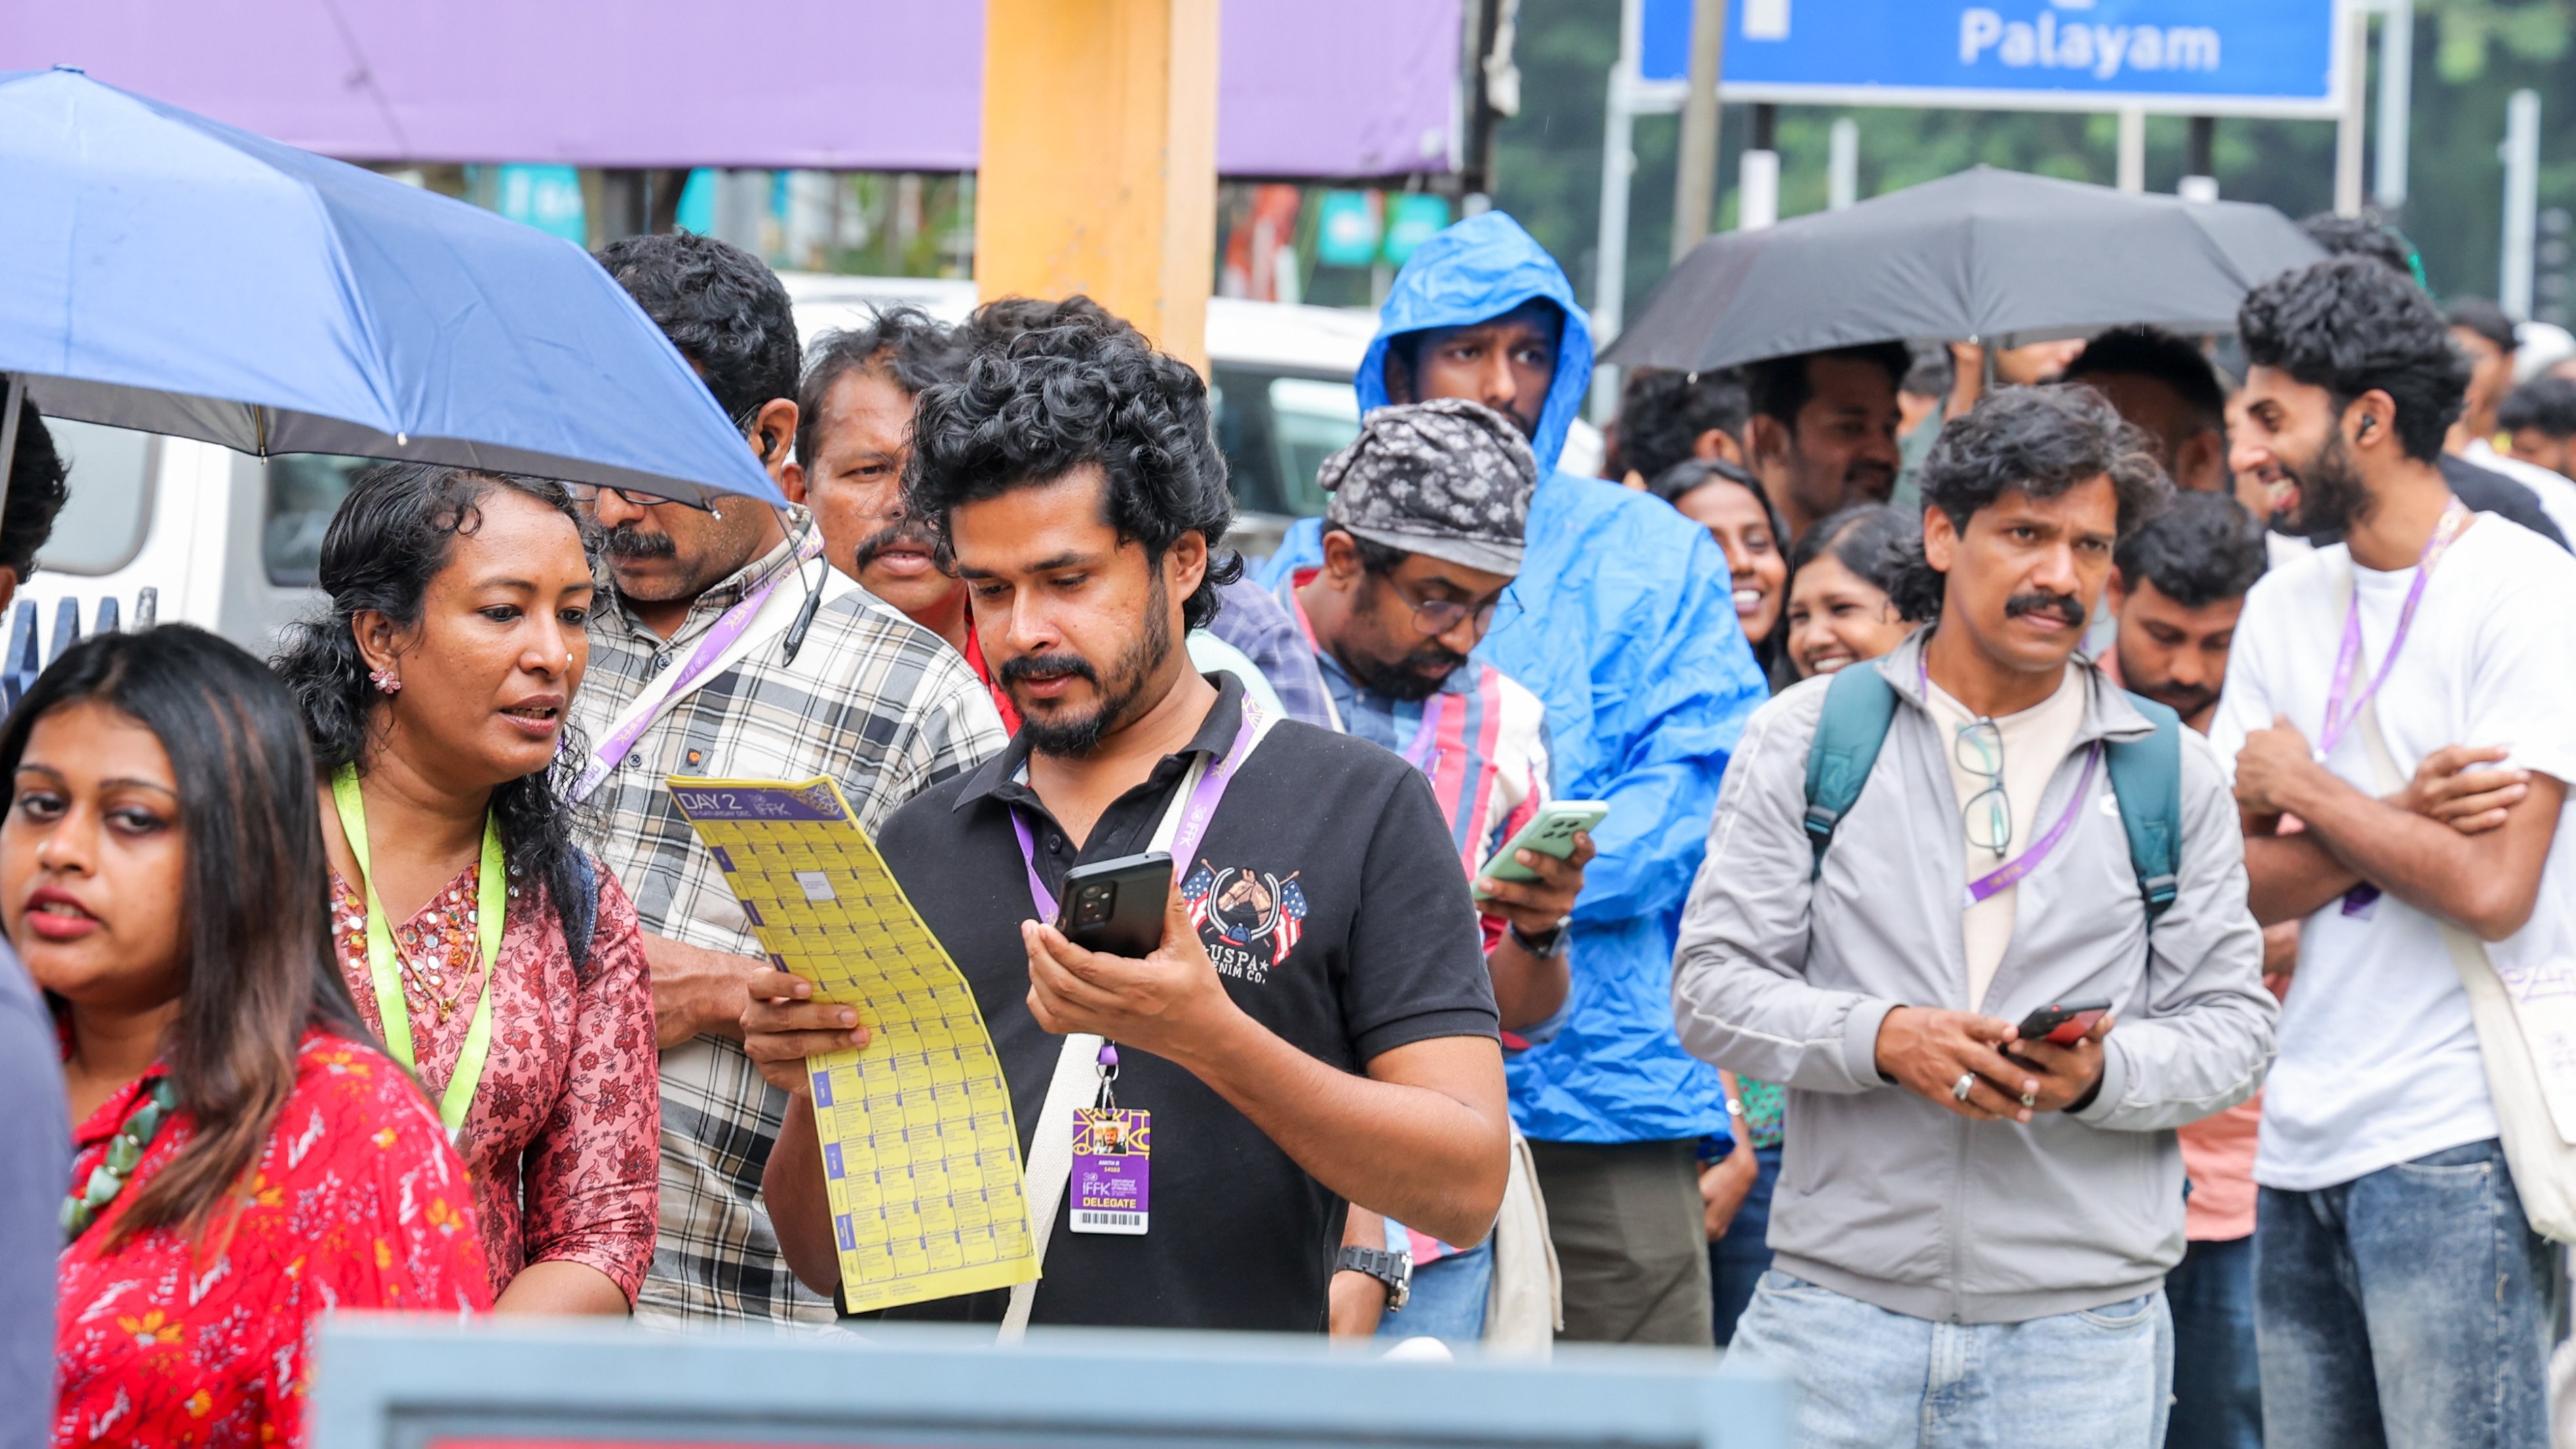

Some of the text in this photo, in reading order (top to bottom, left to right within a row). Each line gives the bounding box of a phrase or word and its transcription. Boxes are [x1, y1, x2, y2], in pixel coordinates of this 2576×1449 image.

[1959, 7, 2221, 80] Palayam
[723, 608, 748, 631] IFFK
[678, 793, 742, 809] DAY 2
[1178, 804, 1207, 847] 30 IFFK
[1210, 944, 1258, 971] USPA
[1212, 961, 1266, 984] ENIM CO.
[1083, 1172, 1098, 1181] 30
[1083, 1182, 1111, 1196] IFFK
[1083, 1197, 1136, 1208] DELEGATE
